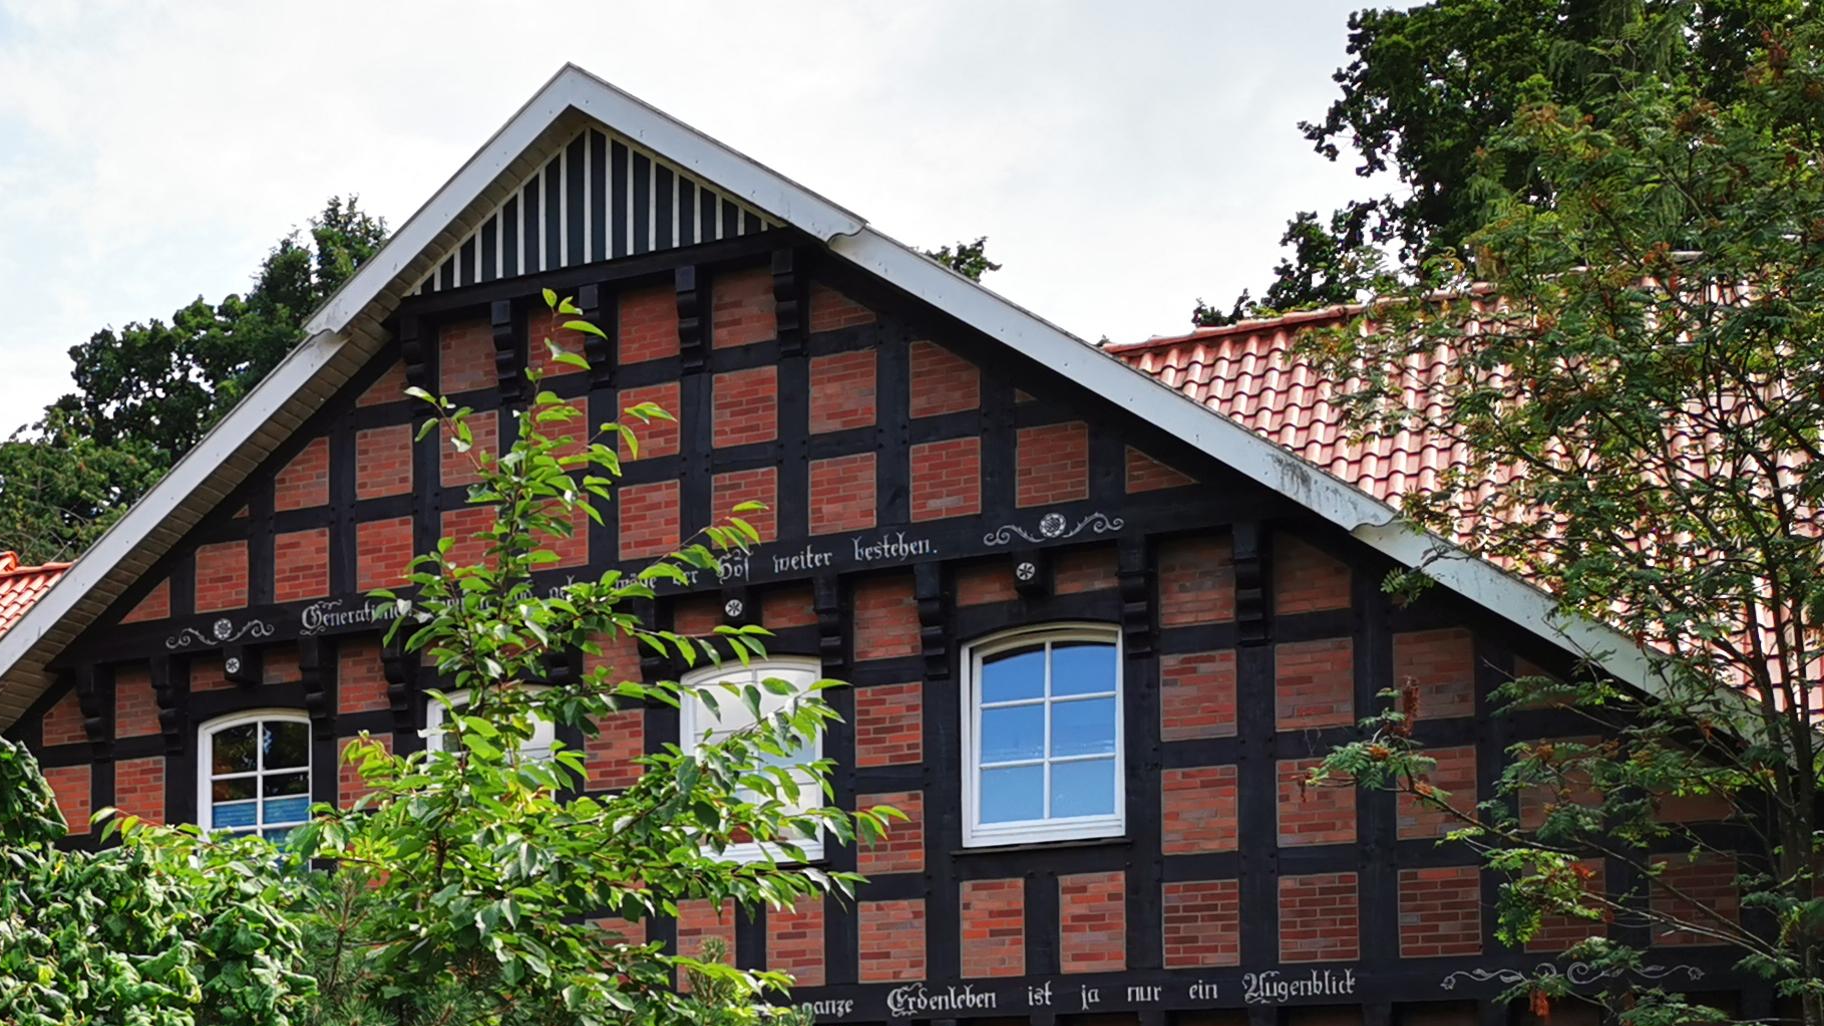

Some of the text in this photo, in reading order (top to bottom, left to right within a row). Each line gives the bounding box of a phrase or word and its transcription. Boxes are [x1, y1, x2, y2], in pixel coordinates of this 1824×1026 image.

[772, 544, 832, 573] weiter
[853, 531, 938, 562] bestehen.
[887, 982, 997, 1017] Erdenleben
[1028, 980, 1053, 1006] ist
[1080, 984, 1100, 1011] ja
[1127, 985, 1162, 1002] nur
[1188, 979, 1218, 1000] ein
[1241, 968, 1356, 1004] Augenblick
